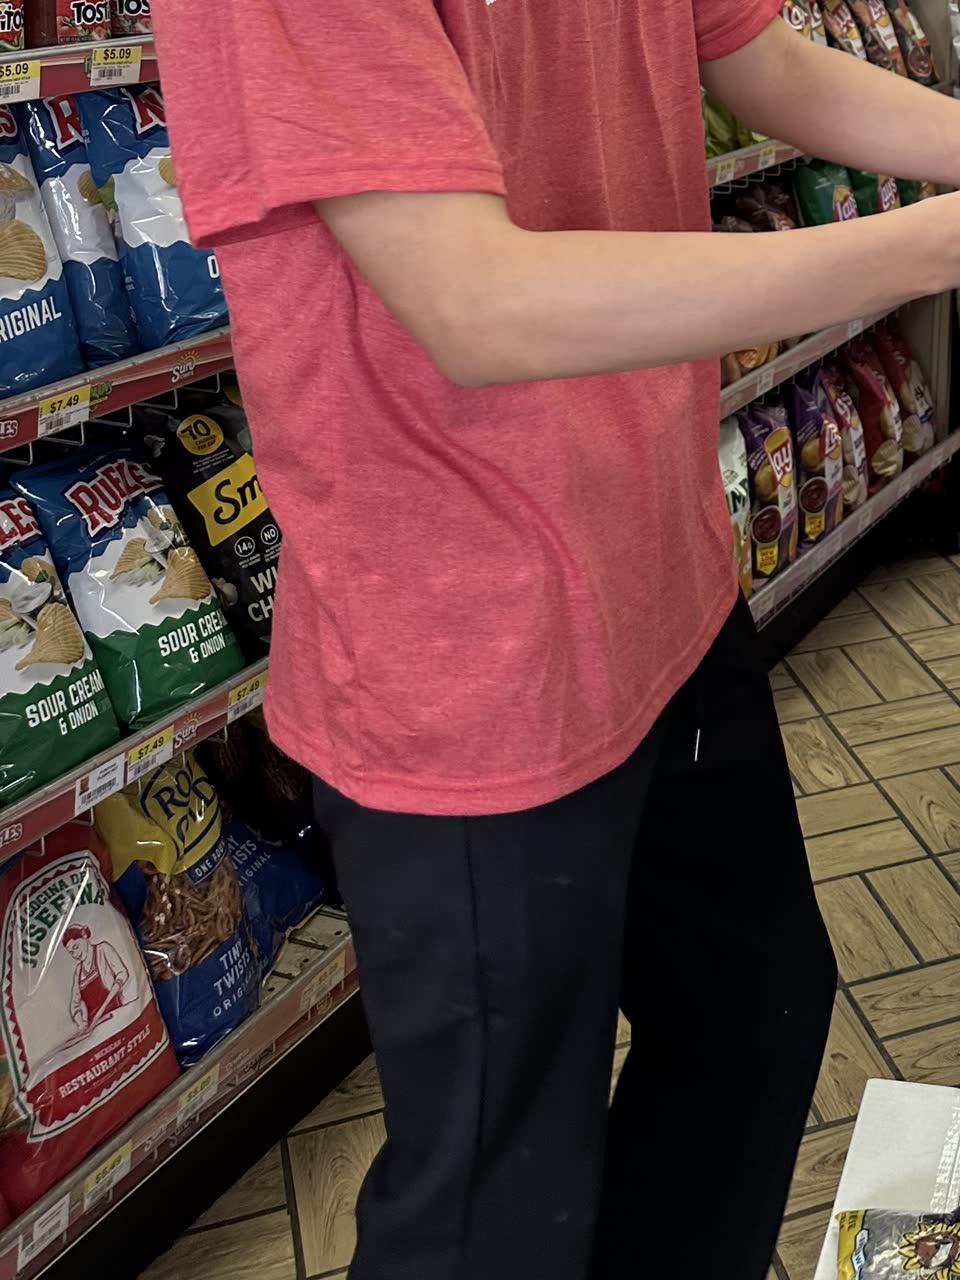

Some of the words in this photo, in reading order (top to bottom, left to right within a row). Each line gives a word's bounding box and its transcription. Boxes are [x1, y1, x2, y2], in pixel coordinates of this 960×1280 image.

[103, 48, 131, 60] $5.09
[50, 394, 79, 414] $7.49
[158, 624, 199, 657] SOUR
[189, 647, 199, 664] &
[201, 632, 227, 659] ONION
[25, 695, 68, 729] SOUR
[59, 718, 68, 736] &
[69, 698, 99, 731] ONION
[138, 736, 165, 758] $7.49
[58, 1048, 127, 1098] RESTAURANT
[127, 1025, 150, 1053] STYLE
